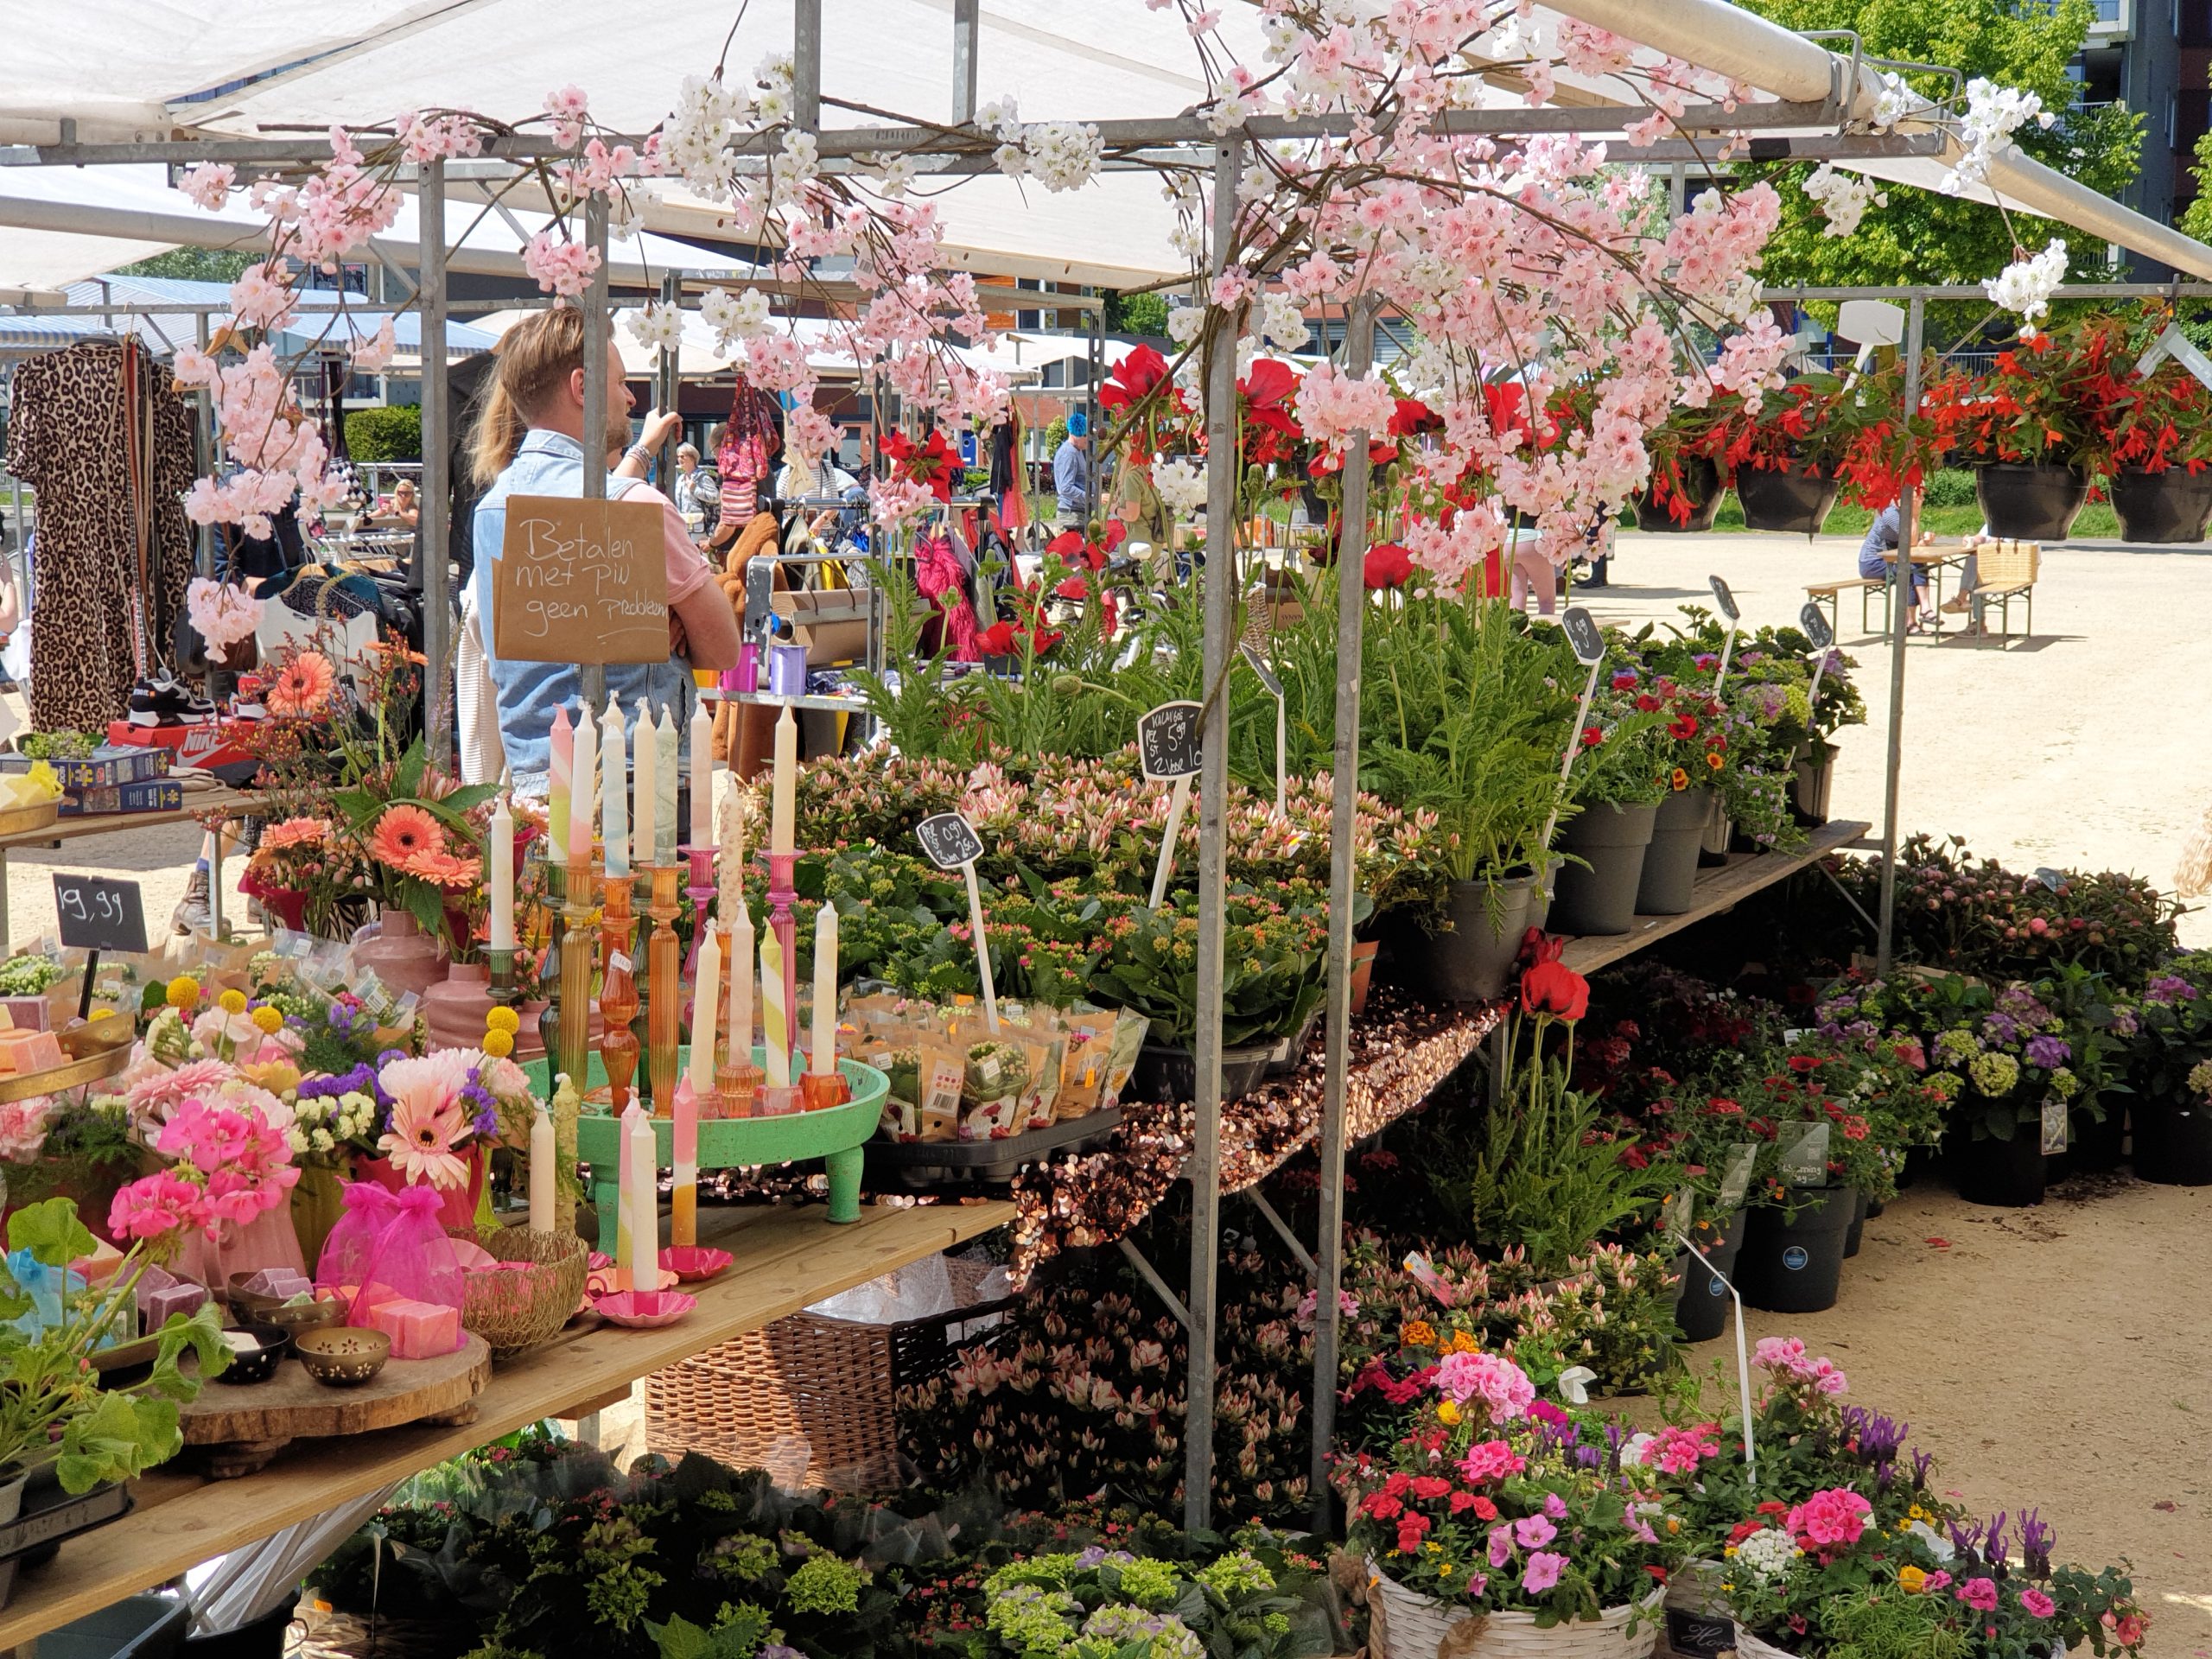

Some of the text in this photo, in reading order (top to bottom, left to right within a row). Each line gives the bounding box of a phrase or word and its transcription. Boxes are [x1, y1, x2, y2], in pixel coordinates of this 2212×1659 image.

[519, 518, 634, 562] Betalen
[517, 562, 574, 588] met
[524, 600, 588, 638] geen
[1783, 1163, 1821, 1175] blming
